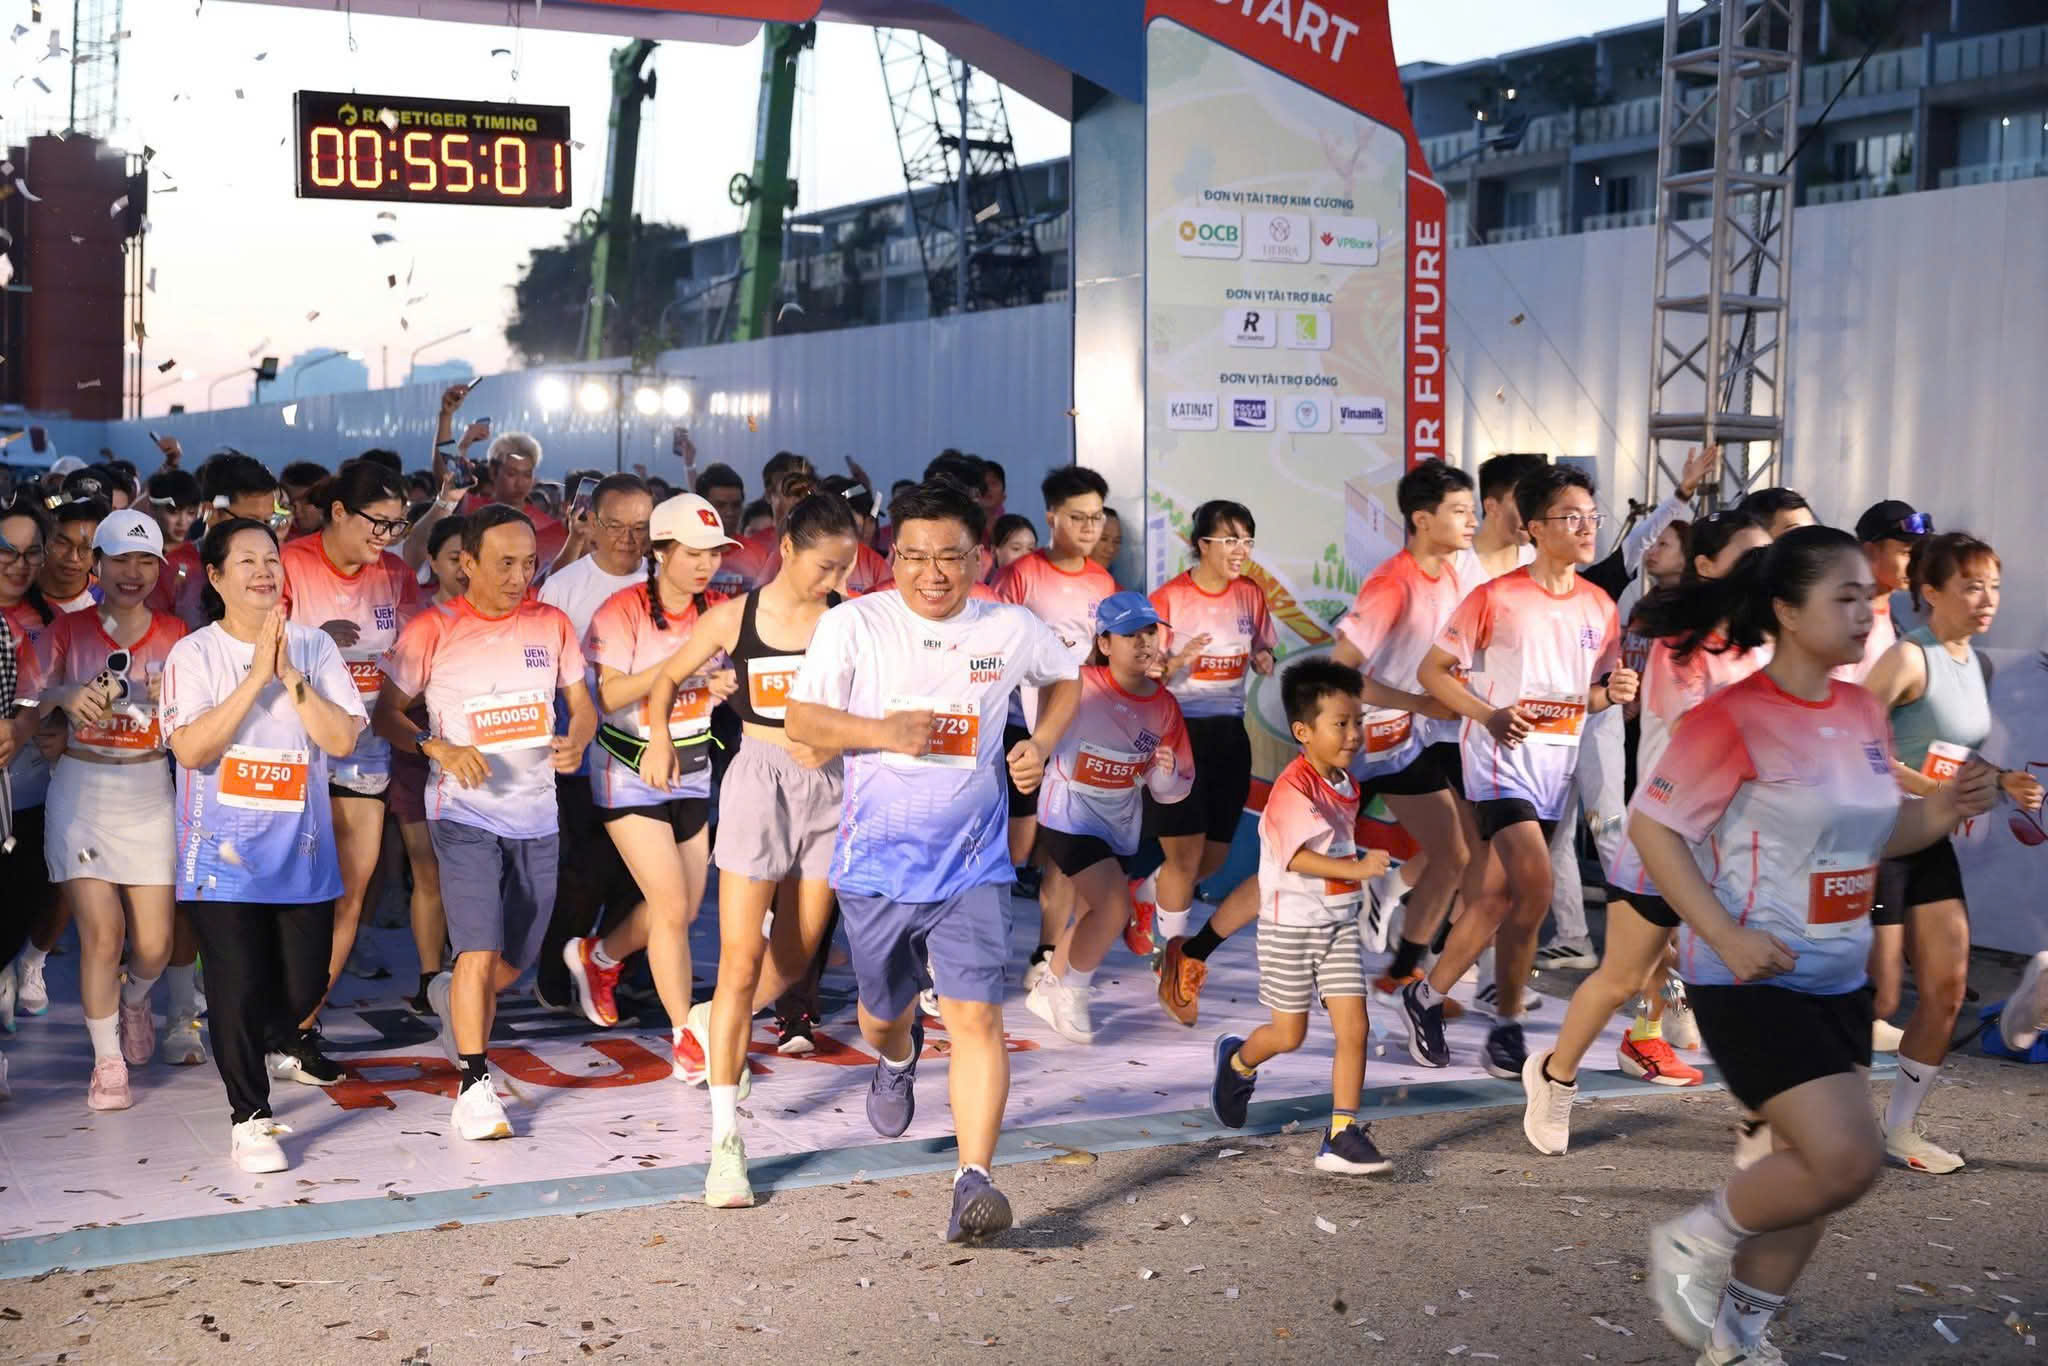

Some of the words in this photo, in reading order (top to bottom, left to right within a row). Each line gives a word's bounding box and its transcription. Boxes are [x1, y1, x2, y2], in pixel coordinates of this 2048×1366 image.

[1215, 0, 1360, 63] ART
[472, 114, 537, 132] TIMING
[311, 127, 563, 195] 00:55:01
[1290, 195, 1311, 207] KIM
[1198, 223, 1238, 242] OCB
[1336, 236, 1373, 249] VPBank
[1226, 288, 1252, 300] ĐƠN
[1415, 221, 1440, 402] FUTURE
[1220, 373, 1246, 385] ĐƠN
[1171, 402, 1213, 417] KATINAT
[1340, 407, 1383, 419] Vinamilk
[374, 608, 395, 619] UEH
[924, 639, 942, 648] UEH
[524, 648, 545, 658] UEH
[525, 658, 546, 668] RUN
[970, 657, 997, 671] UEH
[970, 670, 1000, 684] RUN
[967, 703, 974, 714] 5
[475, 706, 539, 729] M50050
[297, 753, 303, 763] 5
[236, 762, 291, 781] 51750
[1086, 757, 1135, 776] F51551
[192, 793, 205, 818] OUR
[185, 819, 202, 882] EMBRACG
